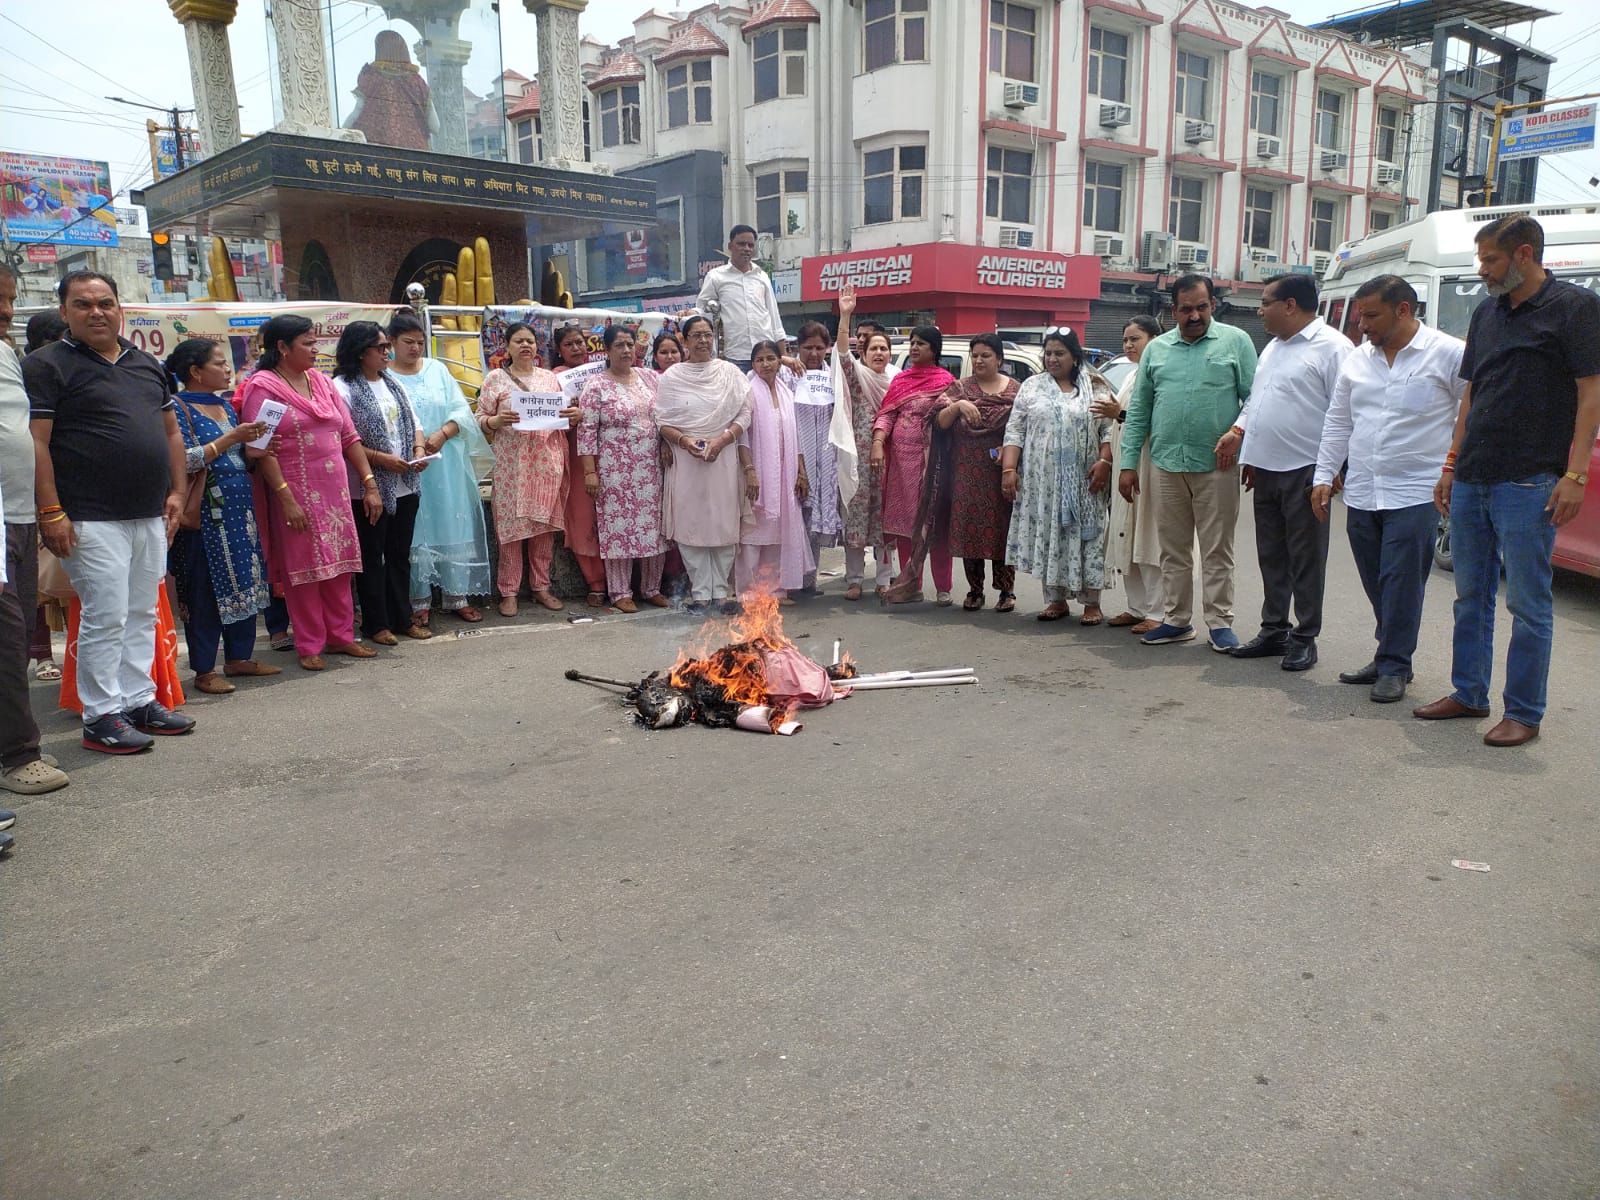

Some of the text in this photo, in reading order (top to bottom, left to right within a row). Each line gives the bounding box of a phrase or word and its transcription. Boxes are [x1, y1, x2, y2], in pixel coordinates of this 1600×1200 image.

[1525, 115, 1548, 126] KOTA
[1550, 107, 1590, 122] CLASSES
[820, 254, 912, 278] AMERICAN
[977, 255, 1067, 274] AMERICAN
[819, 270, 911, 291] TOURISTER
[977, 270, 1066, 289] TOURISTER
[130, 329, 165, 356] 09
[519, 395, 563, 407] कांग्रेस पार्टी
[526, 406, 556, 418] मुर्दाबाद
